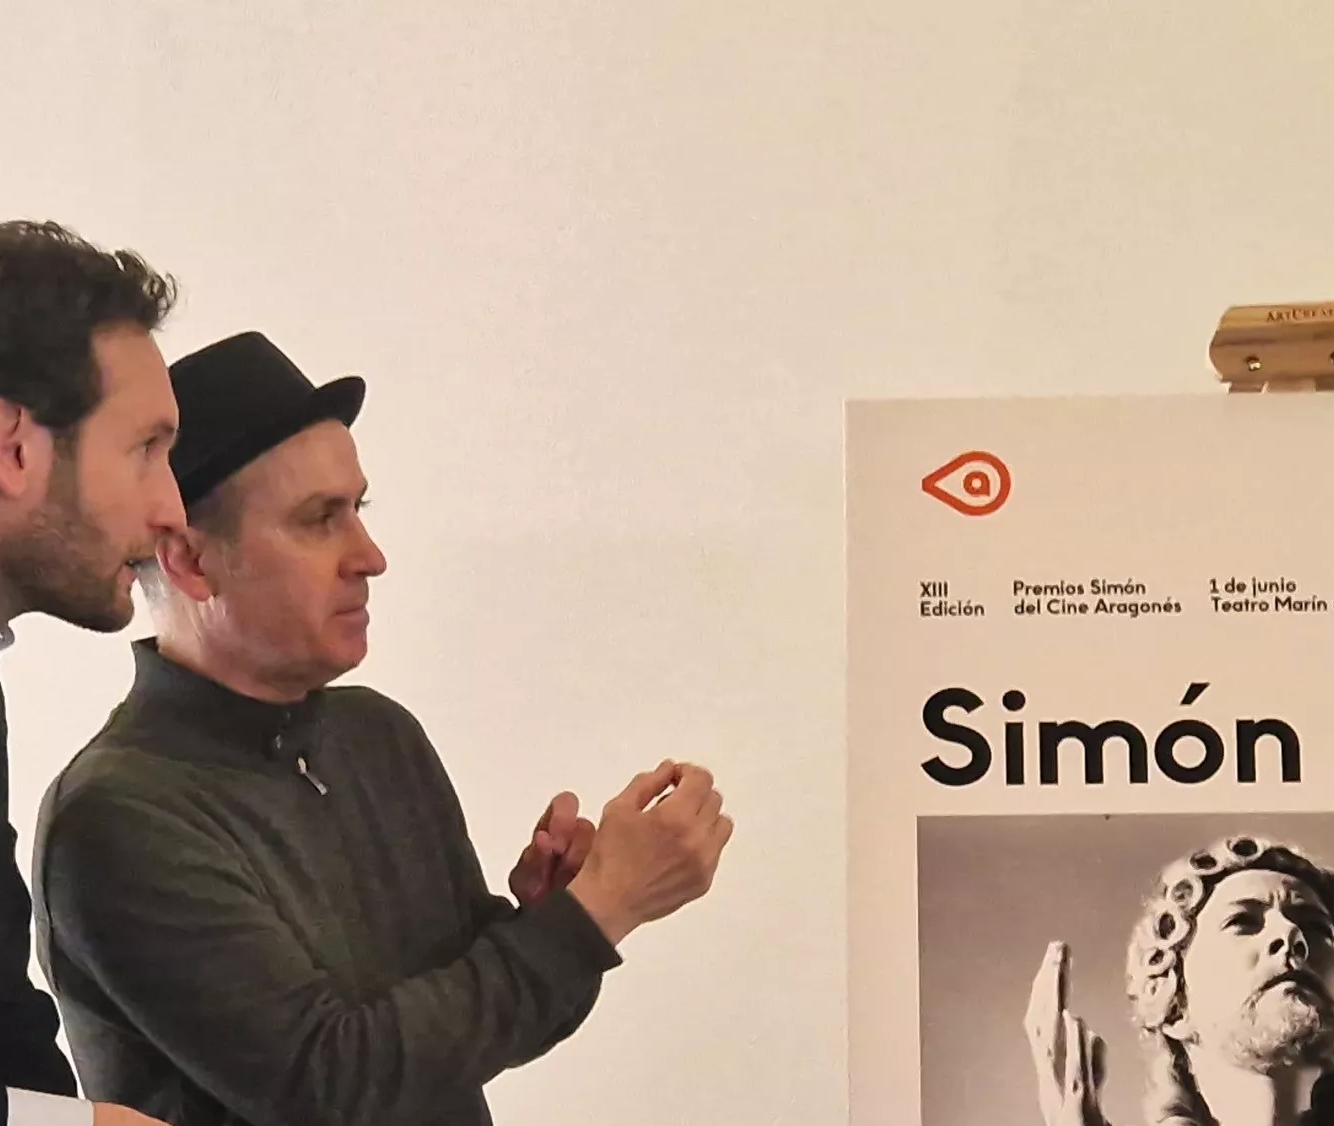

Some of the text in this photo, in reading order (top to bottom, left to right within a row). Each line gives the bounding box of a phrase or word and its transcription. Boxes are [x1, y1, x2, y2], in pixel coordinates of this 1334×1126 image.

[920, 581, 949, 598] XIII
[1013, 578, 1146, 597] Premios Simón
[1210, 576, 1297, 597] 1 de junio
[920, 599, 985, 617] Edición
[1014, 596, 1182, 619] del Cine Aragonés
[1210, 595, 1270, 612] Teatro
[1274, 594, 1328, 612] Marín
[921, 682, 1301, 786] Simón
